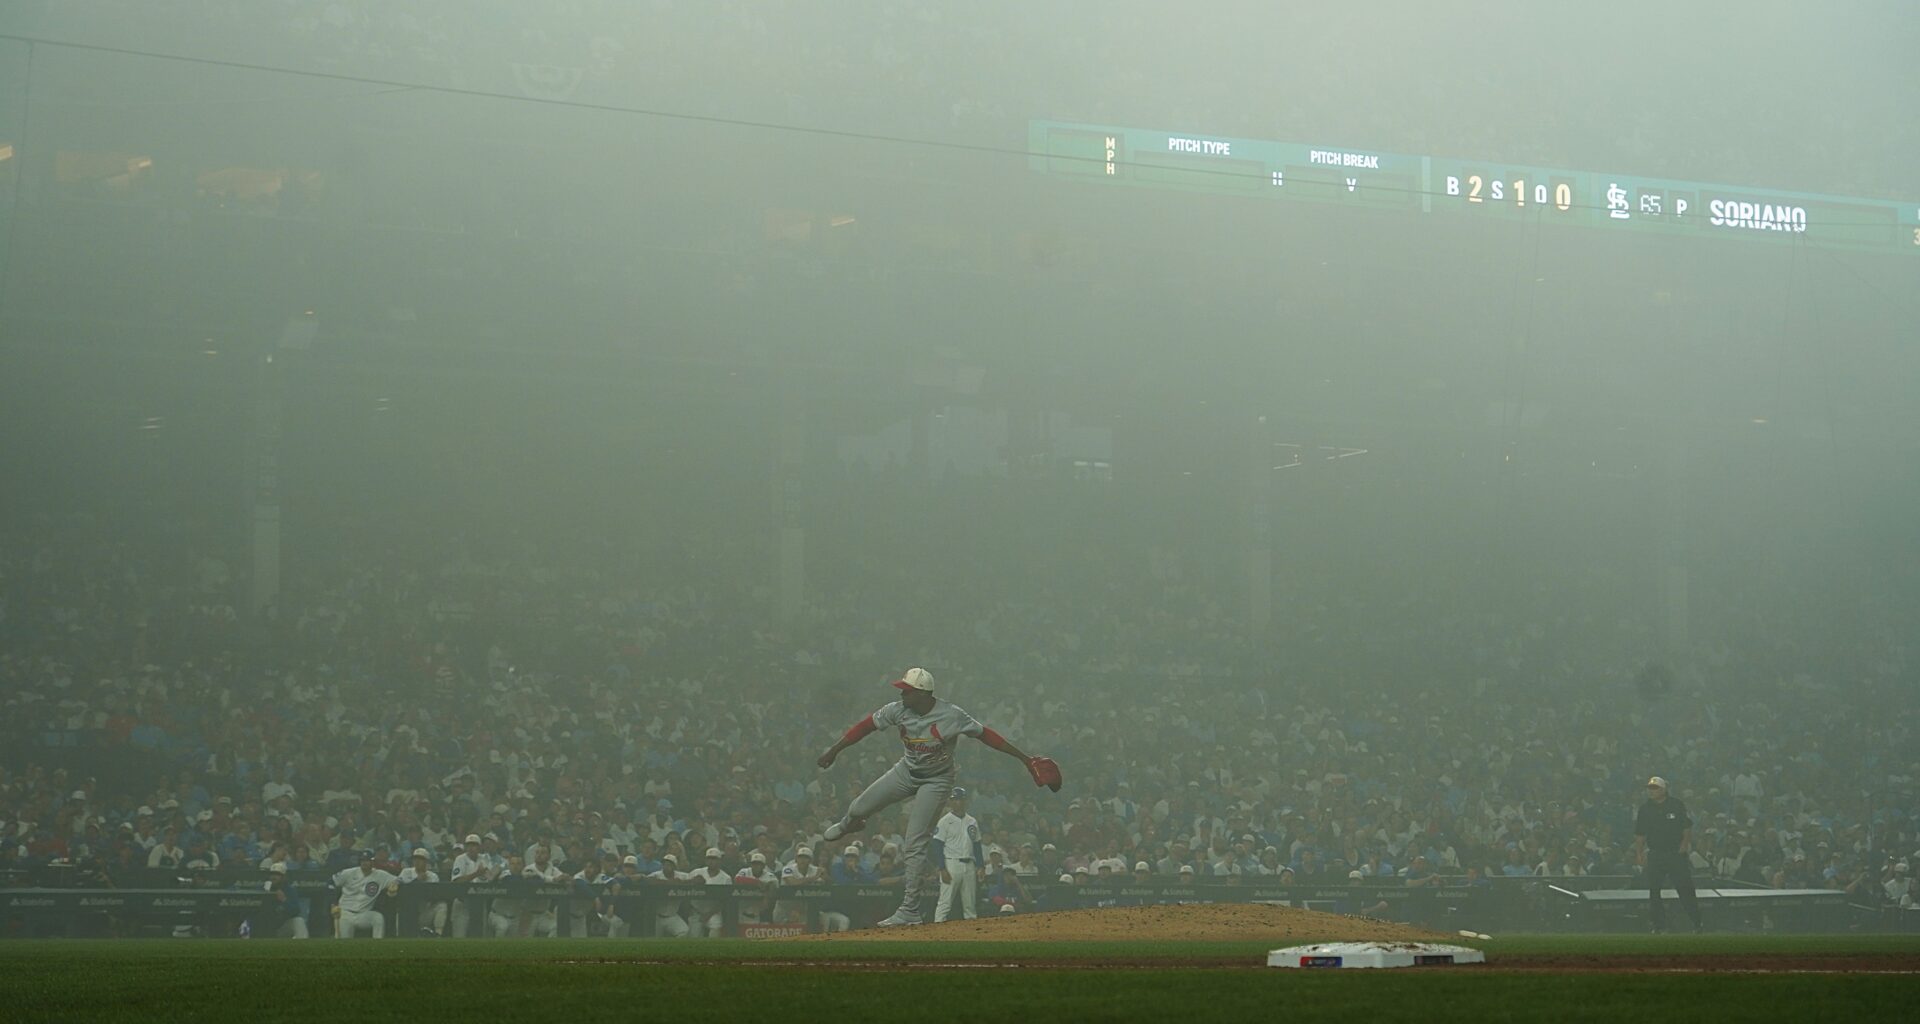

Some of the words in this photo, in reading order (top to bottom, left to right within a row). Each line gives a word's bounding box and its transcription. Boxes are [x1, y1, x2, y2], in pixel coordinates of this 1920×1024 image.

[1168, 138, 1201, 153] PITCH
[1202, 140, 1231, 156] TYPE
[1311, 150, 1342, 166] PITCH
[1344, 153, 1379, 169] BREAK
[1447, 176, 1460, 196] B
[1469, 176, 1483, 203] 2
[1492, 181, 1504, 200] S
[1514, 180, 1525, 207] 1
[1677, 199, 1688, 217] P
[1710, 200, 1807, 232] SORIANO
